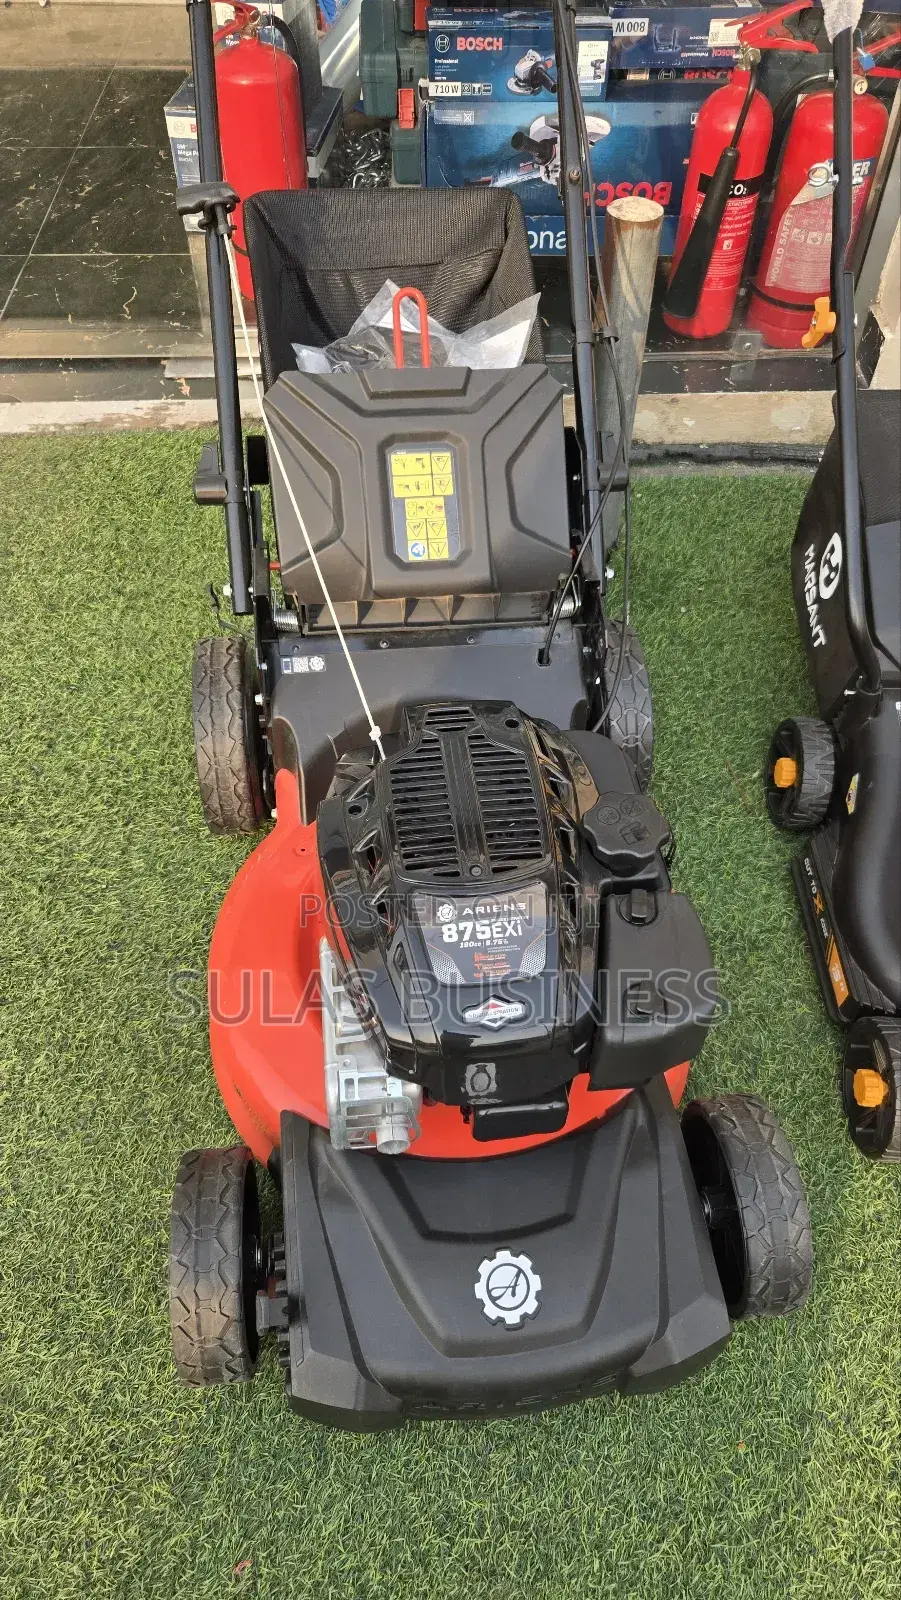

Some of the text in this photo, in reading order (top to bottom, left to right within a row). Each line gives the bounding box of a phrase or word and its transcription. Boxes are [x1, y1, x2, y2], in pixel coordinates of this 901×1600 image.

[615, 22, 646, 33] 800 W
[456, 37, 503, 51] BOSCH
[435, 84, 459, 94] 710 W
[770, 206, 796, 283] WORLD SAFETY
[804, 544, 827, 648] MARSANT
[804, 857, 813, 876] CUT
[810, 880, 818, 895] TO
[462, 902, 527, 916] ARIENS
[441, 919, 523, 943] 875EXi
